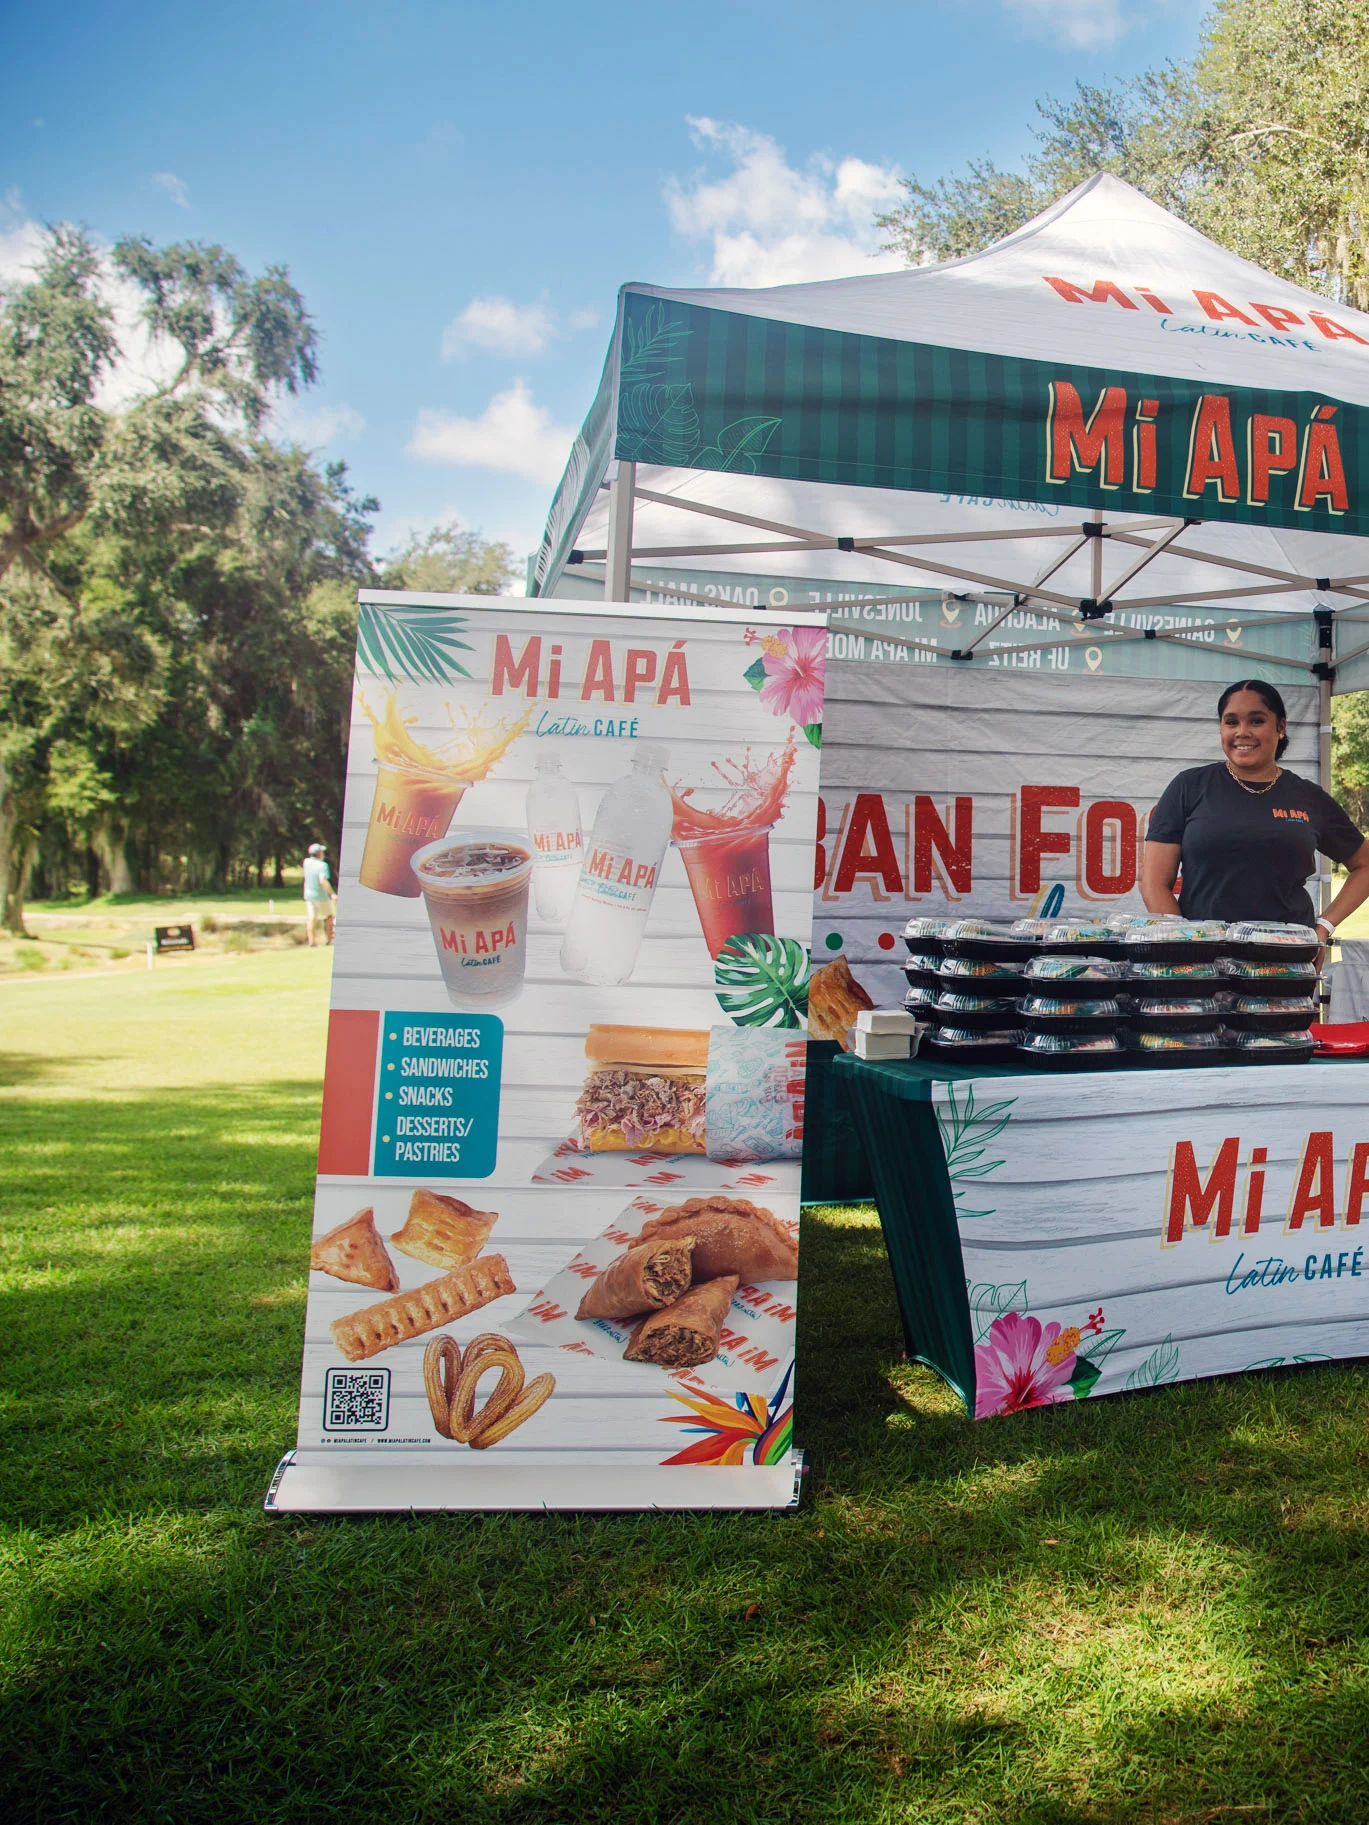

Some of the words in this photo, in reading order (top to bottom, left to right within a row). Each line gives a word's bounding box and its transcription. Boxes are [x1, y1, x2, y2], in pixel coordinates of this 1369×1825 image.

[1043, 276, 1173, 315] Mi
[1161, 318, 1247, 340] Latin
[1248, 332, 1322, 353] CAFÉ
[1047, 380, 1160, 491] Mi
[1183, 393, 1350, 515] APÁ
[489, 635, 562, 700] Mi
[577, 640, 691, 709] APÁ
[536, 710, 590, 738] Latin
[593, 718, 639, 738] CAFÉ
[377, 802, 401, 829] Mi
[556, 828, 581, 851] APÁ
[814, 793, 973, 898] AN
[589, 848, 615, 879] Mi
[616, 857, 658, 889] APÁ
[439, 927, 467, 954] Mi
[475, 921, 516, 954] APÁ
[402, 1027, 480, 1048] BEVERAGES
[400, 1057, 488, 1079] SANDWICHES
[399, 1086, 453, 1106] SNACKS
[396, 1116, 474, 1137] DESSERTS/
[395, 1142, 461, 1162] PASTRIES
[1160, 1136, 1268, 1250] Mi
[1226, 1252, 1302, 1295] Latin
[1303, 1246, 1364, 1280] CAFÉ
